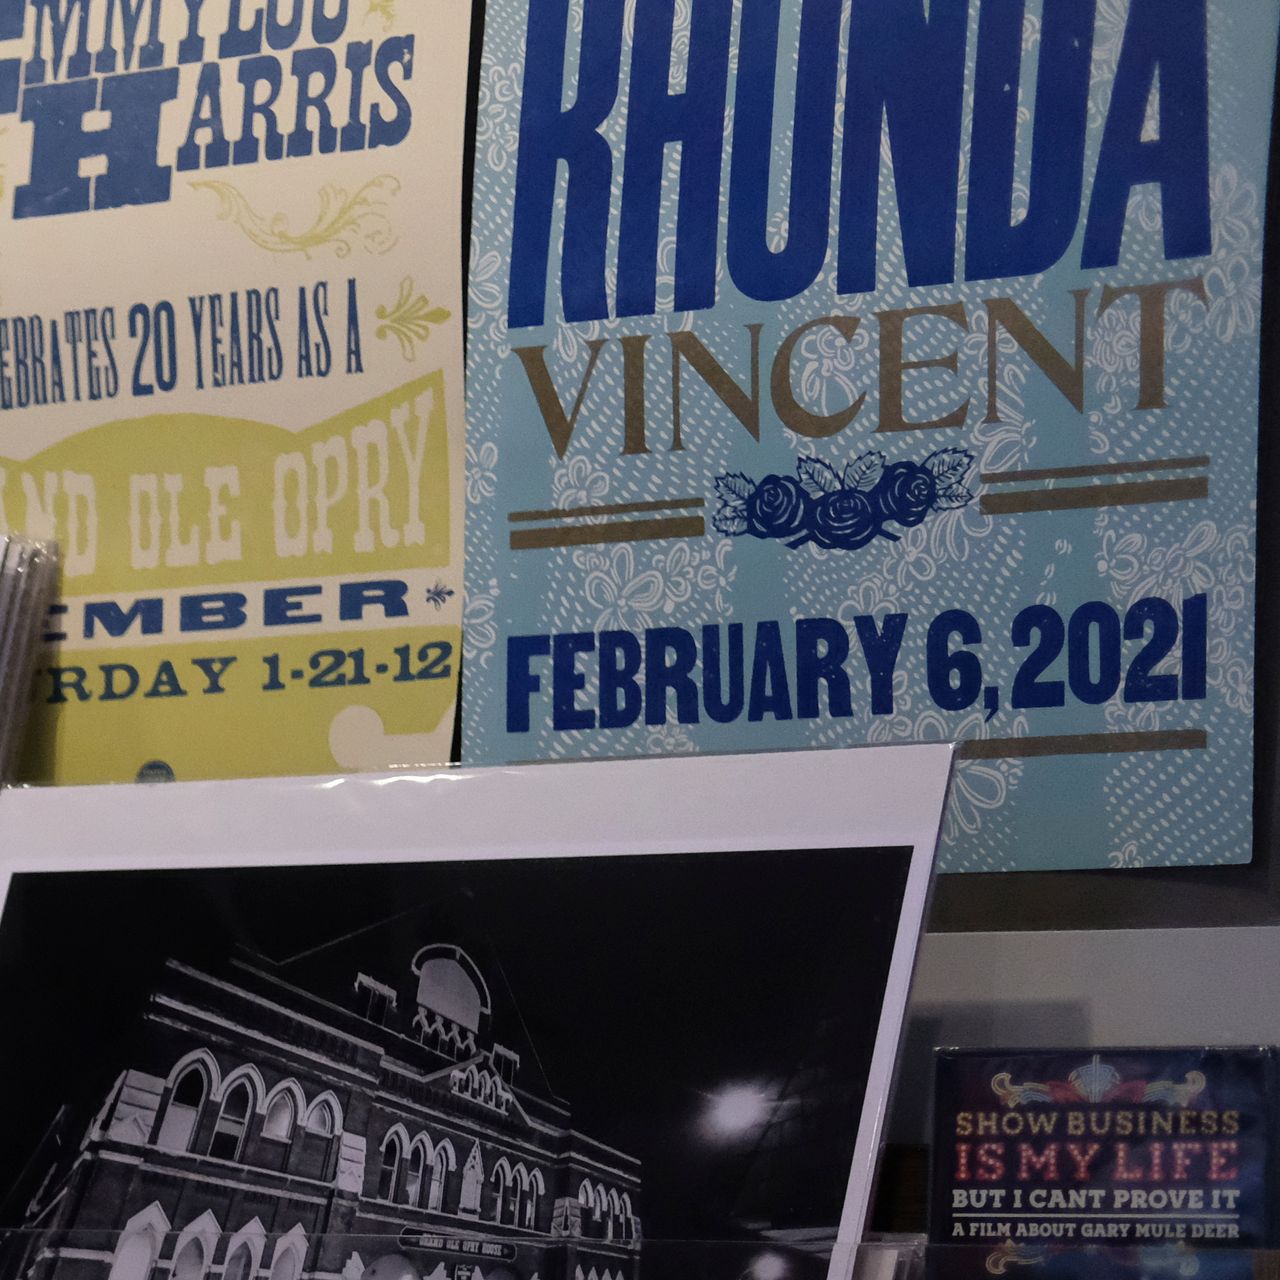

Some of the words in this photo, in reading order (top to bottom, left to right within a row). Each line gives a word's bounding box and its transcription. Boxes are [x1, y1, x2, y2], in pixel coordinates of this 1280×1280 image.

[13, 34, 416, 220] HARRIS
[128, 300, 178, 396] 20
[188, 285, 284, 390] YEARS
[297, 281, 330, 378] AS
[346, 277, 364, 375] A
[511, 277, 1210, 460] VINCENT
[127, 465, 243, 571] OLE
[272, 390, 436, 559] OPRY
[505, 613, 909, 734] FEBRUARY
[954, 1142, 1007, 1181] IS
[1017, 1143, 1101, 1181] MY
[1113, 1141, 1238, 1181] LIFE
[955, 1111, 1059, 1136] SHOW
[1066, 1110, 1240, 1136] BUSINESS
[952, 1189, 1006, 1208] BUT
[1013, 1189, 1023, 1208] I
[1114, 1189, 1204, 1209] PROVE
[1211, 1189, 1240, 1209] IT
[952, 1223, 965, 1237] A
[969, 1222, 1011, 1237] FILM
[1016, 1223, 1077, 1237] ABOUT
[1081, 1223, 1128, 1239] GARY
[1135, 1223, 1186, 1239] MULE
[1191, 1223, 1239, 1239] DEER
